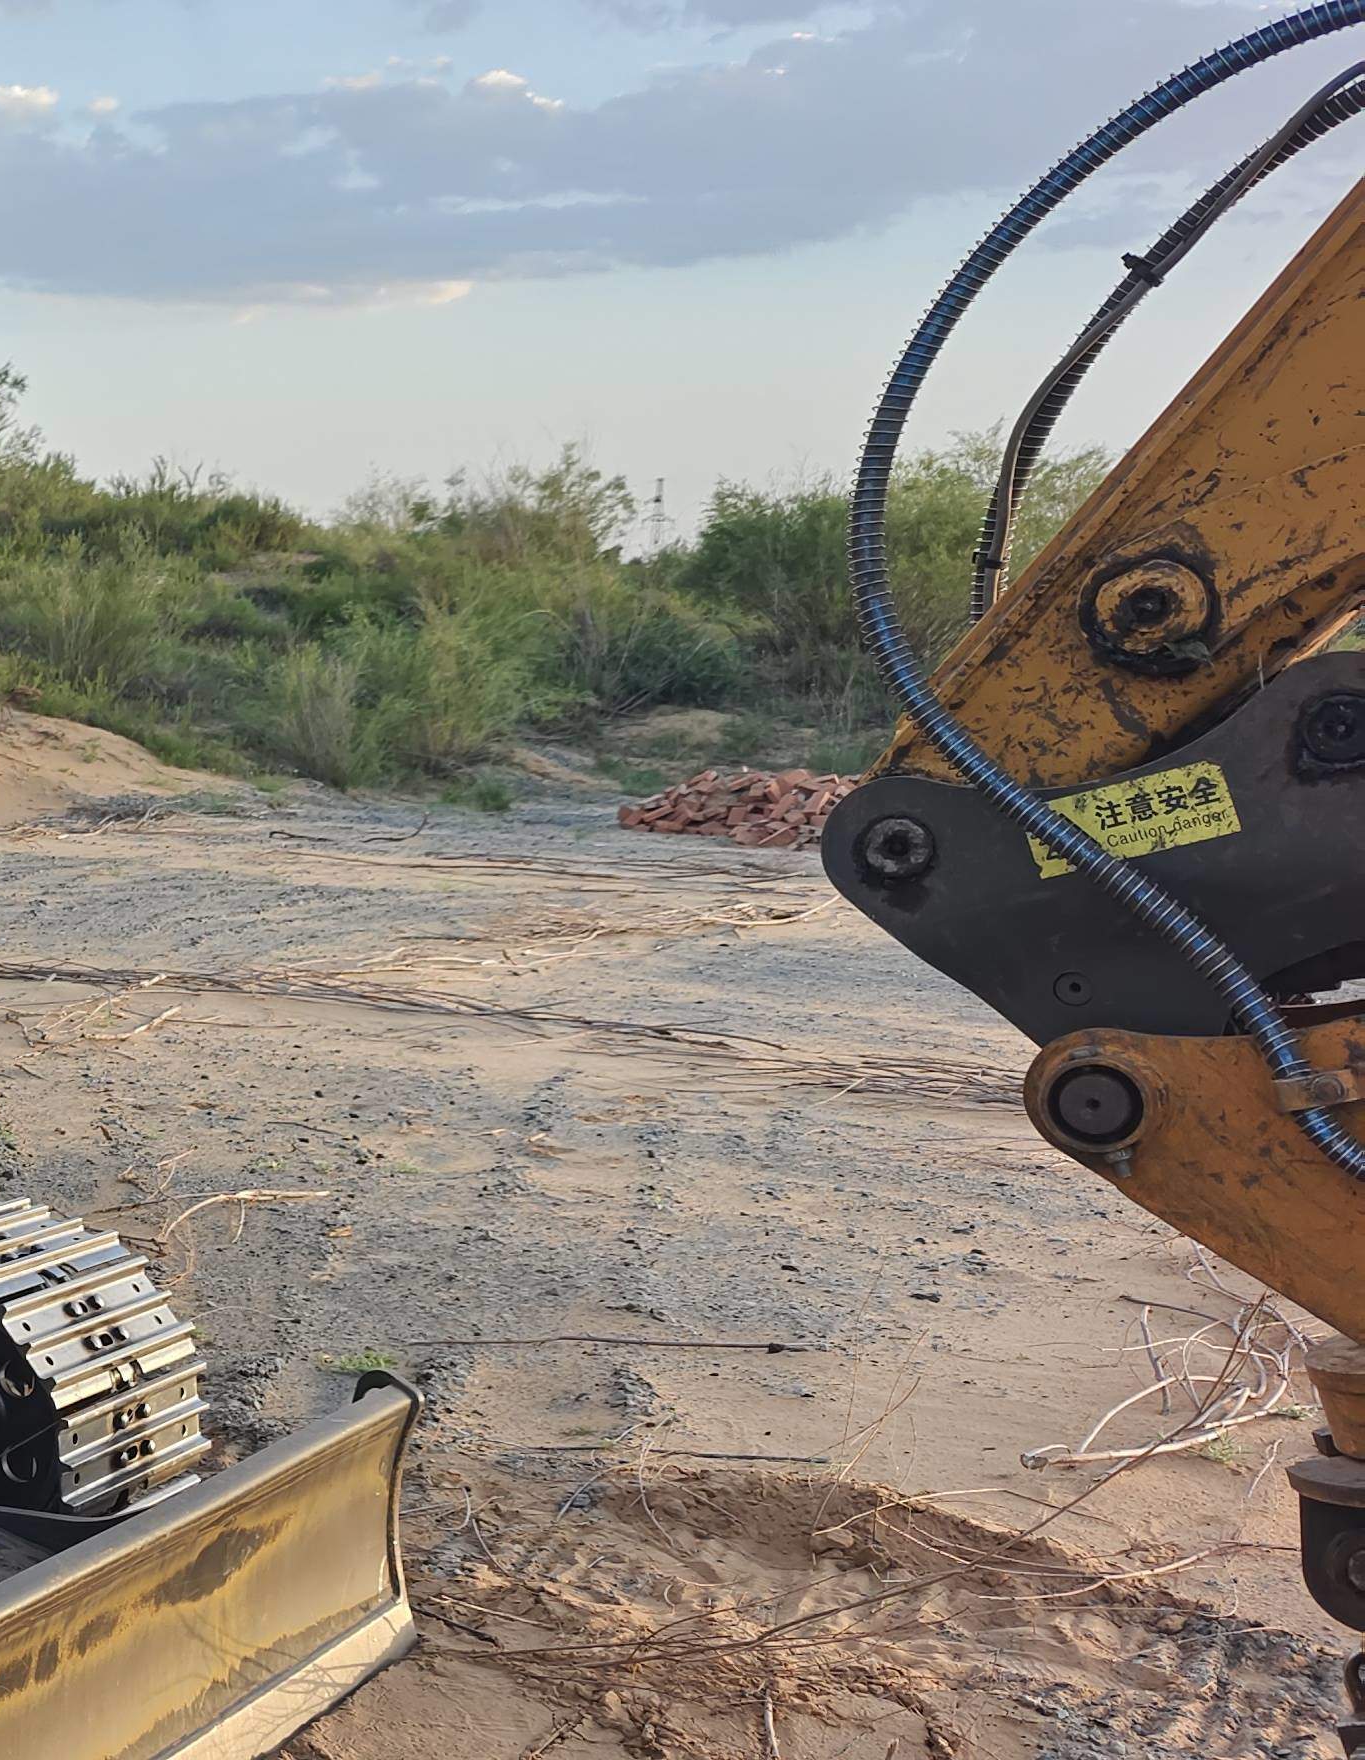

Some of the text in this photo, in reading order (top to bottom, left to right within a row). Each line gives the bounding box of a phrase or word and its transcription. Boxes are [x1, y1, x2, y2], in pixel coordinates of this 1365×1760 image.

[1095, 777, 1220, 830] 注意安全
[1107, 810, 1226, 848] Caution danger
